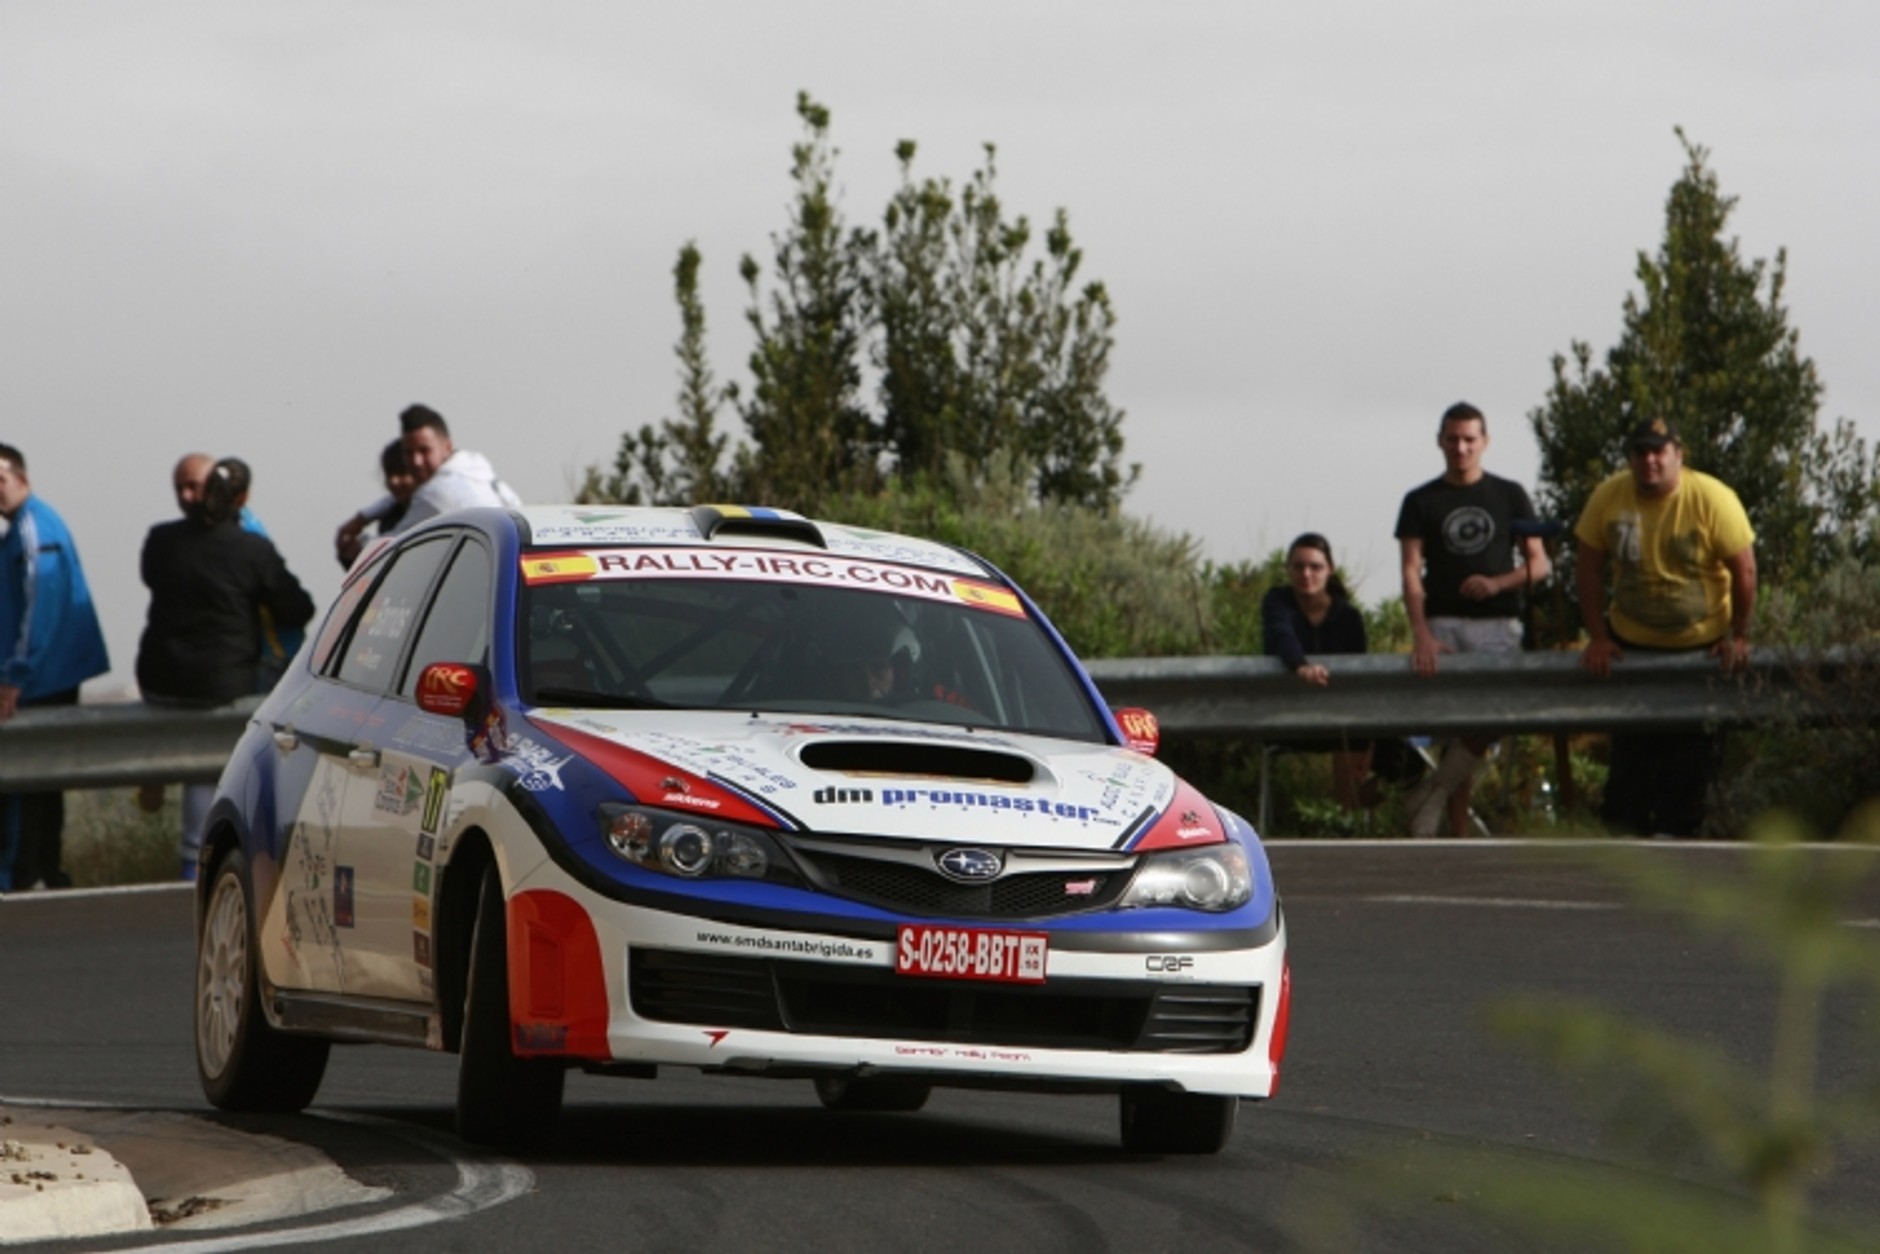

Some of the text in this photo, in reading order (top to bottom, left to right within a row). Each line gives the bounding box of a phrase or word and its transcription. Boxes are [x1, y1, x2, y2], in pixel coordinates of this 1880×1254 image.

[600, 554, 951, 595] RALLY-IRC.COM
[426, 667, 468, 693] IRC
[813, 786, 873, 804] dm
[881, 788, 1100, 822] promaster
[697, 932, 873, 957] www.smdsantabrigida.es
[900, 928, 1019, 977] S-0258-BBT
